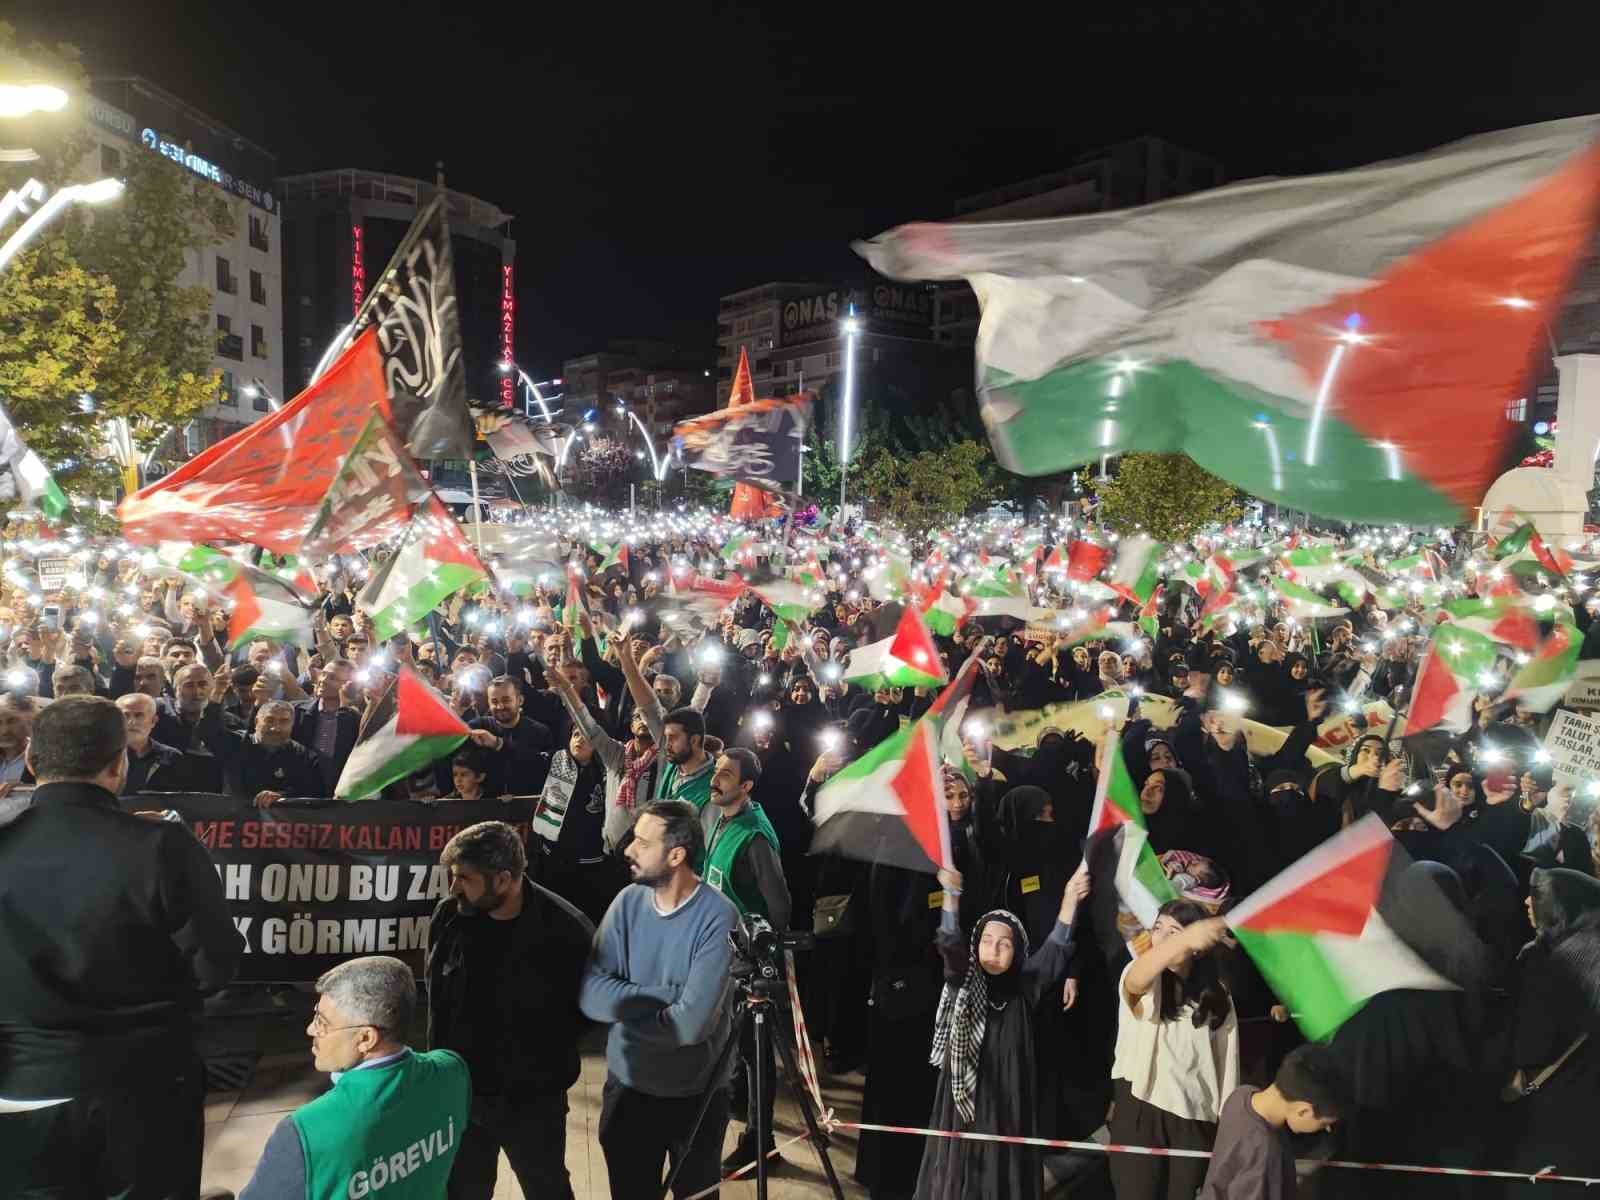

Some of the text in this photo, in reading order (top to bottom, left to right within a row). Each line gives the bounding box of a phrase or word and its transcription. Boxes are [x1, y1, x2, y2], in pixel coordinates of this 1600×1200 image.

[339, 824, 422, 852] KALAN
[214, 863, 252, 900] H
[260, 863, 340, 902] ONU
[348, 864, 400, 902] BU
[261, 912, 432, 956] GÖRMEM
[348, 1115, 454, 1200] GÖREVLİ
